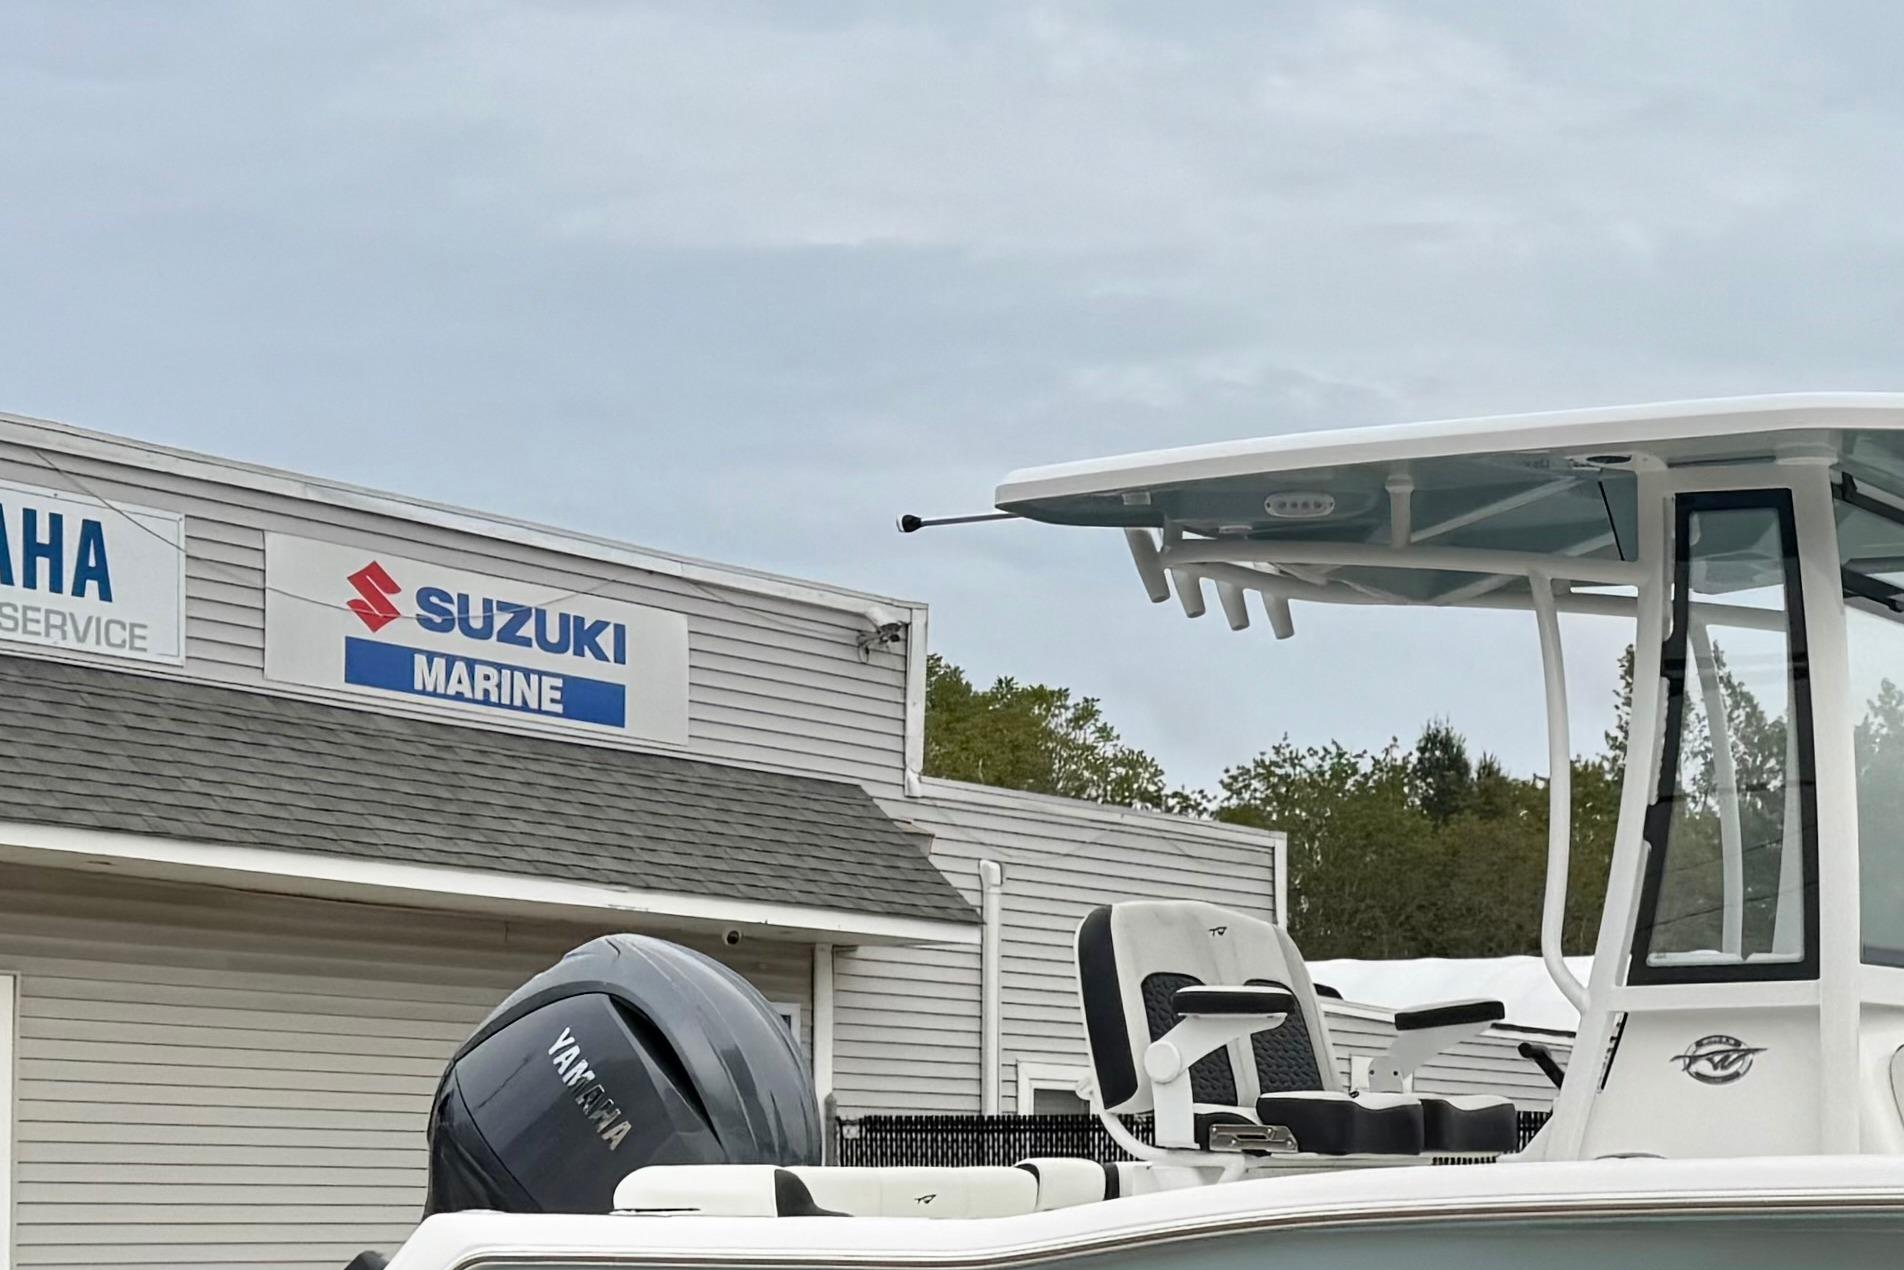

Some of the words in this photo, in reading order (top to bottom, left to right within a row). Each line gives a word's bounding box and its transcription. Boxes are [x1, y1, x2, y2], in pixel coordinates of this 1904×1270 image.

[0, 602, 148, 652] SERVICE
[415, 586, 626, 665] SUZUKI
[413, 653, 563, 714] MARINE
[548, 1026, 632, 1151] YAMAHA
